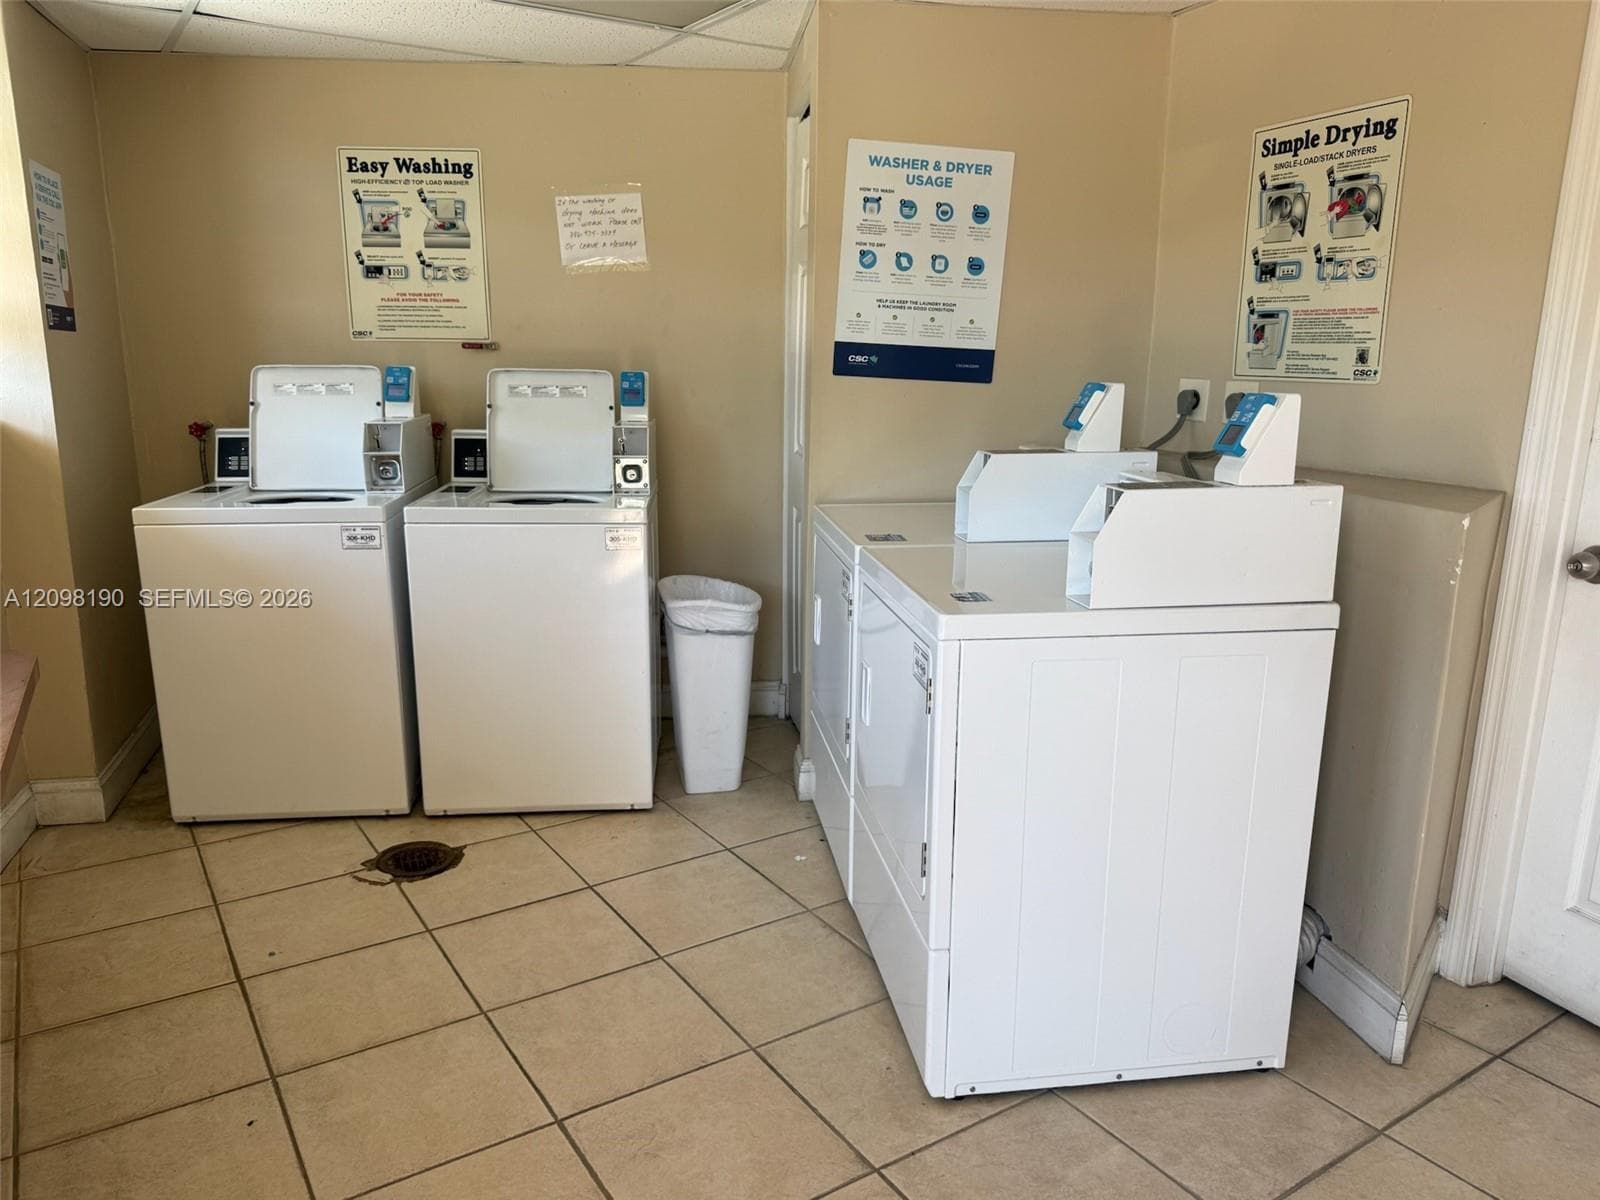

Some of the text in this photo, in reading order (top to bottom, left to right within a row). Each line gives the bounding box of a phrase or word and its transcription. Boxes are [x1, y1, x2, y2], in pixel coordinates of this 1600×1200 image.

[1261, 117, 1399, 158] Simple Drying
[346, 156, 473, 179] Easy Washing
[868, 154, 993, 176] WASHER & DRYER
[1273, 152, 1345, 171] SINGLE-LOAD/STACK
[1346, 145, 1377, 158] DRYERS
[905, 174, 954, 188] USAGE
[1353, 369, 1373, 377] CSC
